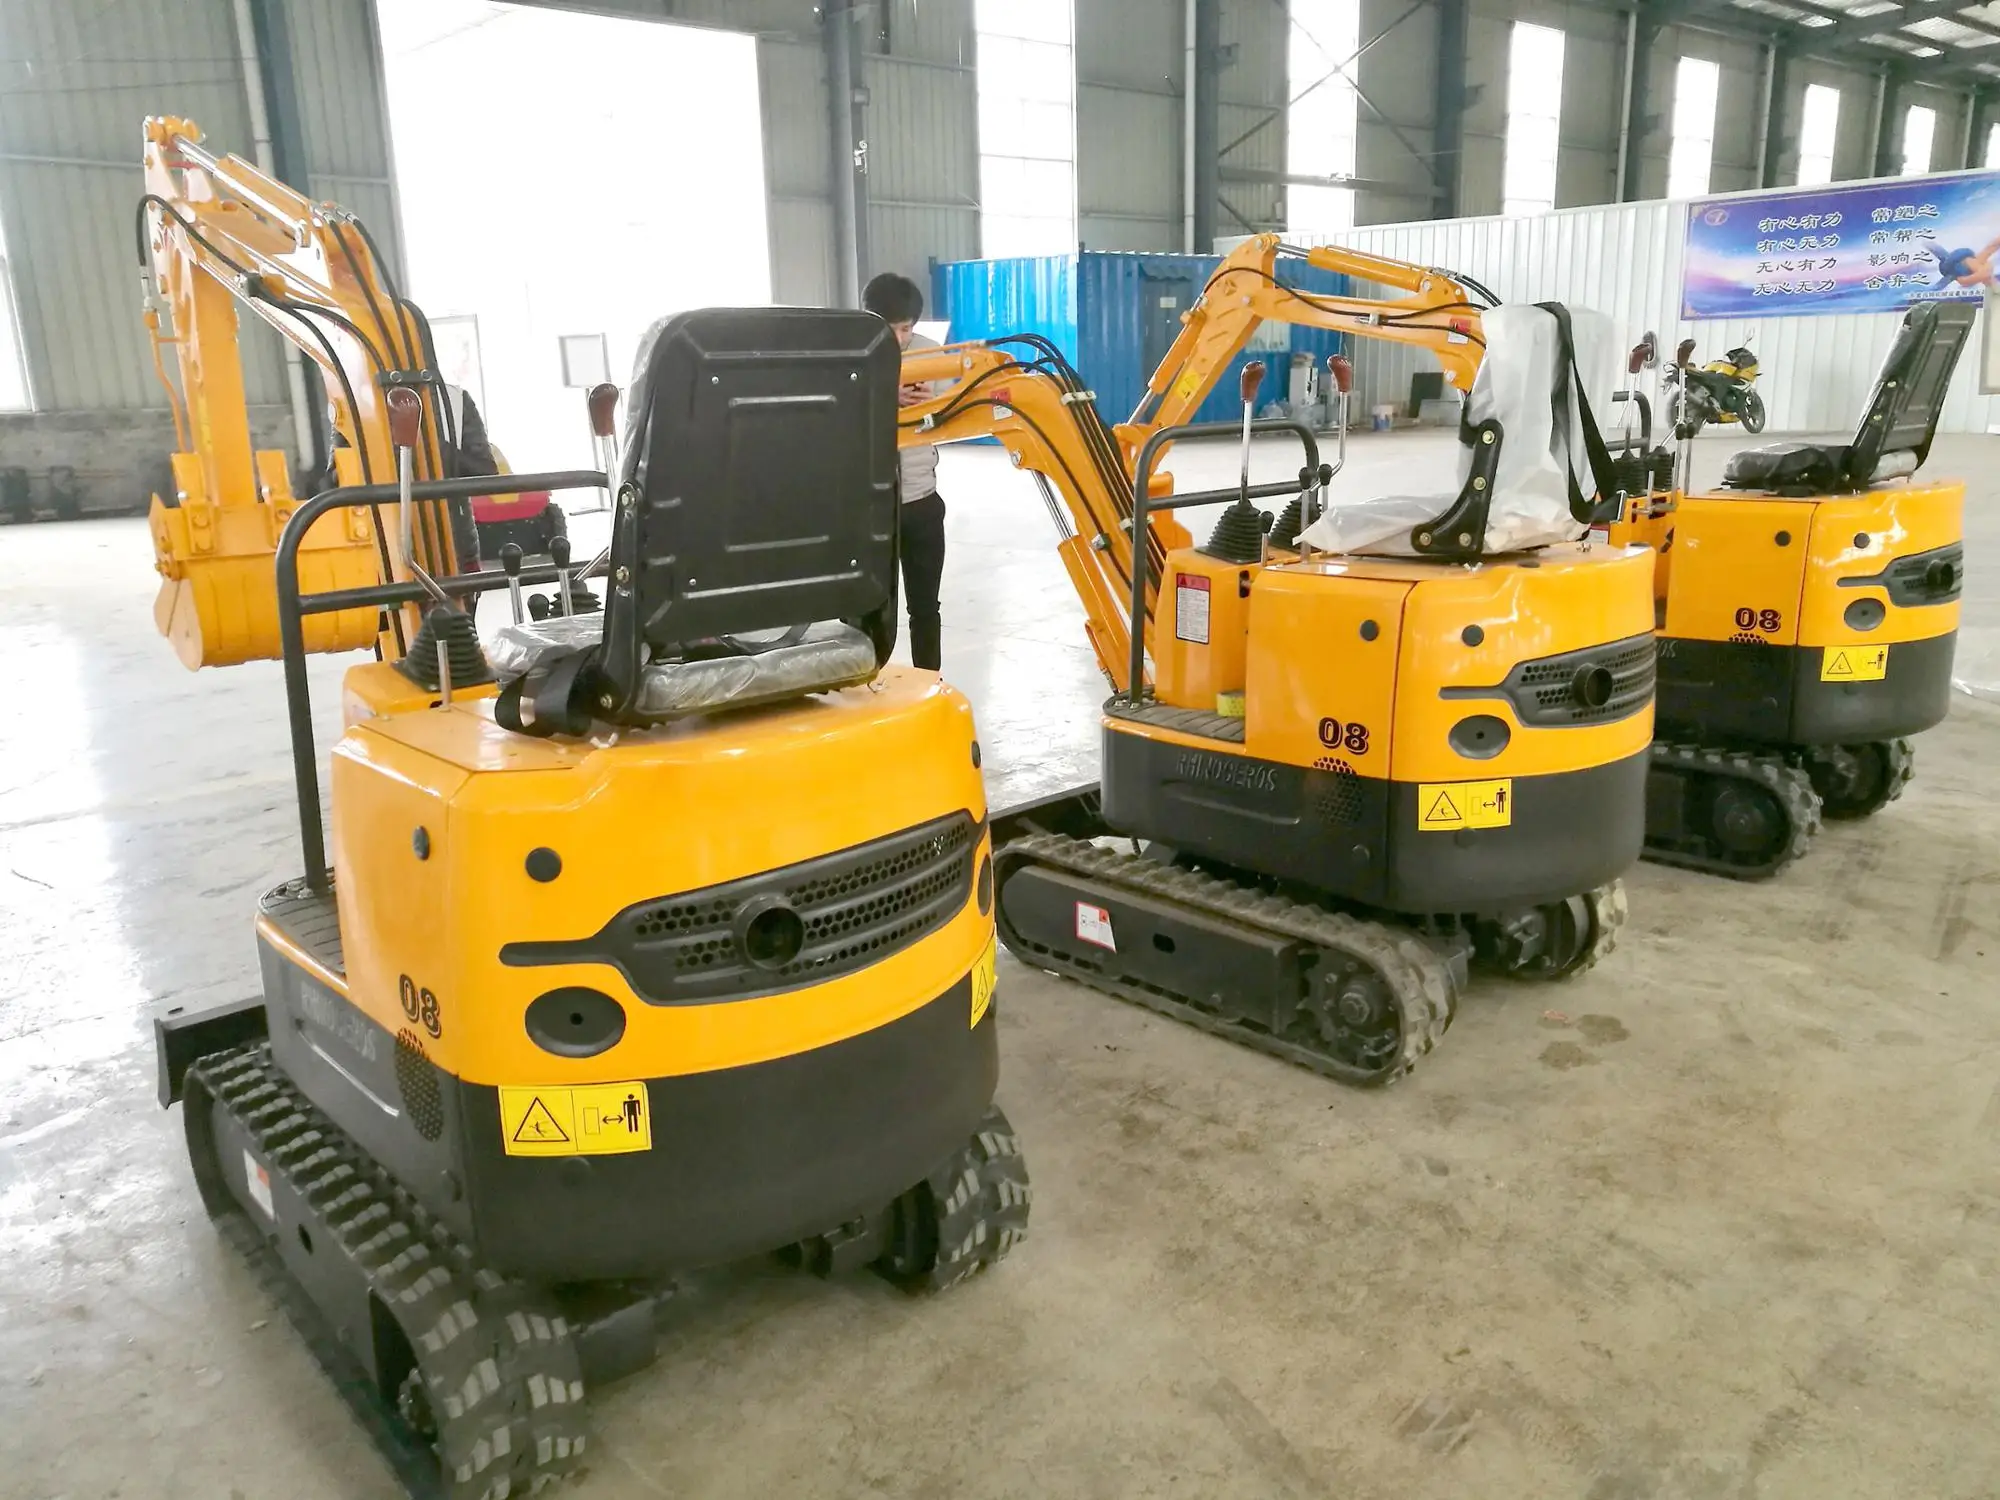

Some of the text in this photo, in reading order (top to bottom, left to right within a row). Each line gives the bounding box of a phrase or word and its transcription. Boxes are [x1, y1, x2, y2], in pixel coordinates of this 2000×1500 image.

[1759, 212, 1842, 233] 有心有力
[1757, 234, 1840, 254] 有心无力
[1756, 251, 1932, 274] 无心有力 影响之
[1754, 273, 1931, 296] 无心无力 舍弃之
[1735, 608, 1781, 633] 08
[1318, 717, 1369, 754] 08
[398, 974, 442, 1039] 08
